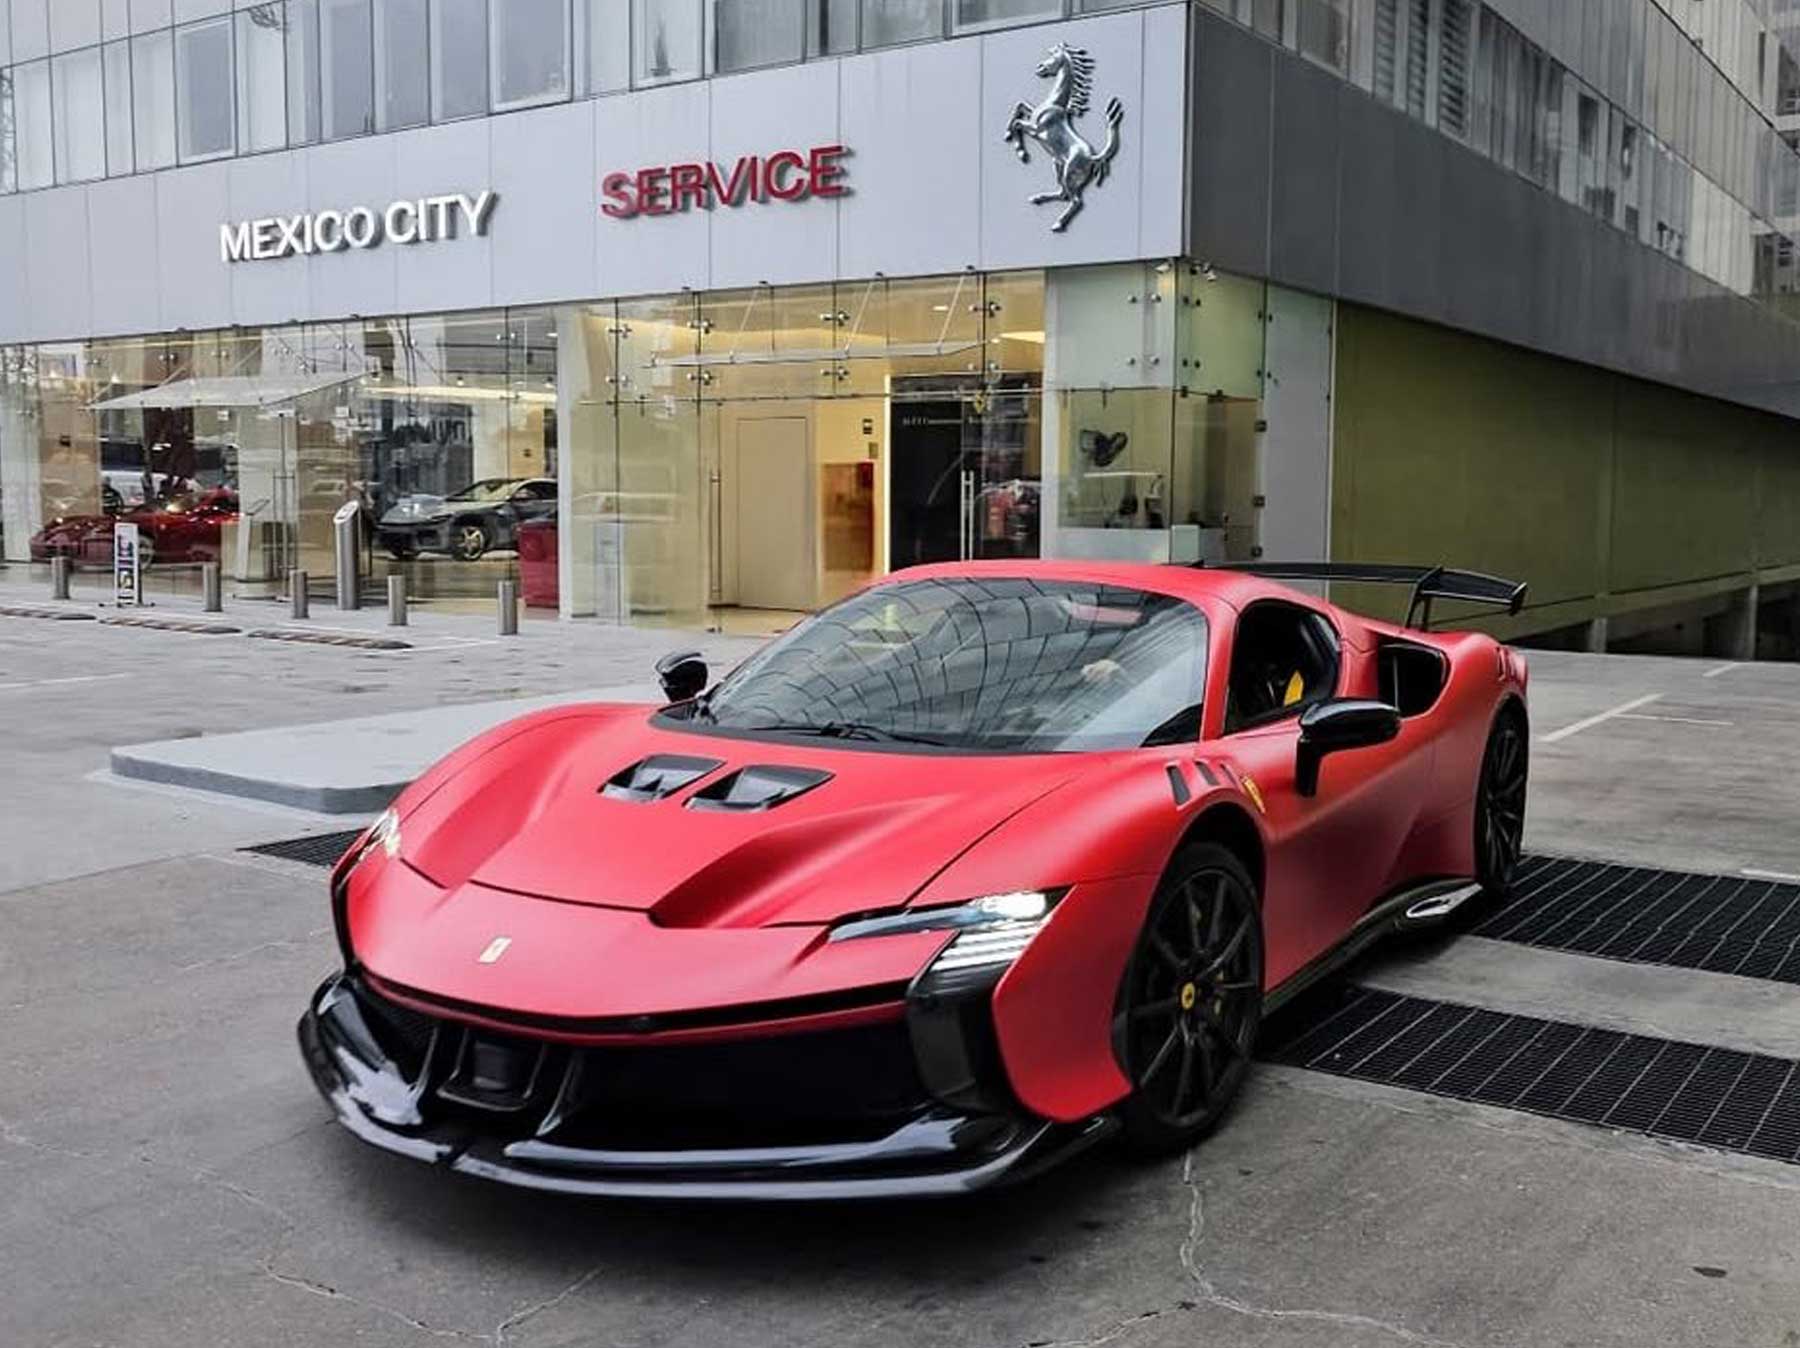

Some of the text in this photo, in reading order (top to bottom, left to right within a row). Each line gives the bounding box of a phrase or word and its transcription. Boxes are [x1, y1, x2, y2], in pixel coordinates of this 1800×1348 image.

[601, 145, 846, 218] SERVICE
[219, 189, 493, 262] MEXICO CITY
